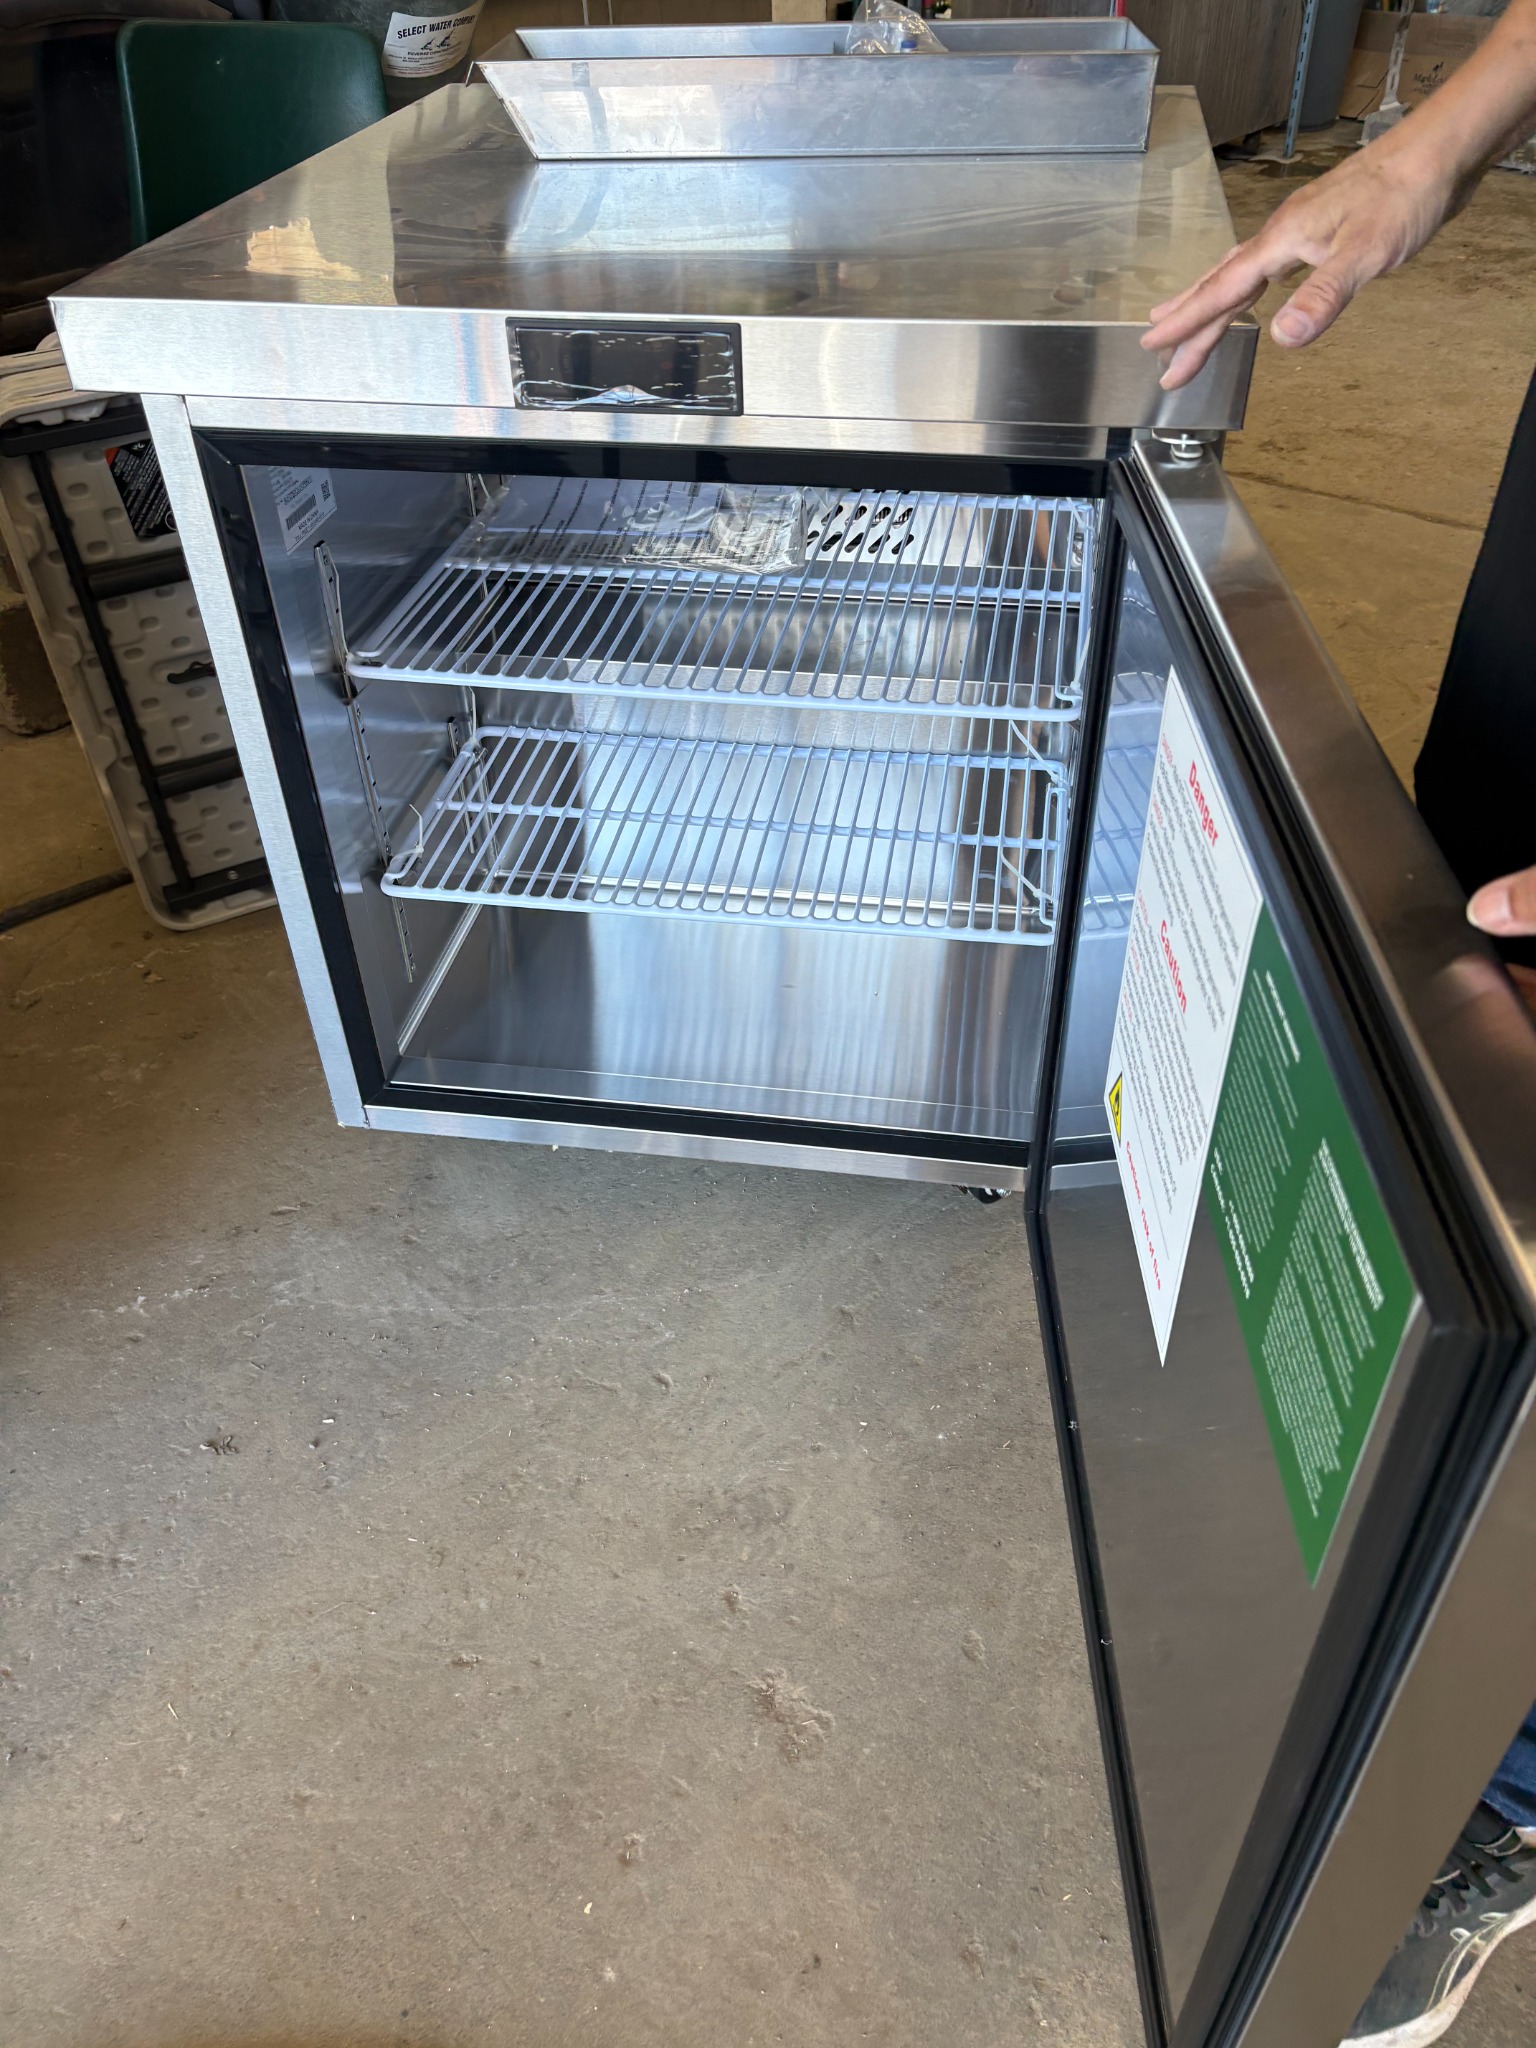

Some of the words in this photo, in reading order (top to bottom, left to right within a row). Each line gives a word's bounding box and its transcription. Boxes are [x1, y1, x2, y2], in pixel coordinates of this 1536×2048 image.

[397, 24, 427, 40] SELECT
[429, 20, 452, 32] WATER
[1189, 760, 1218, 846] Danger
[1161, 919, 1188, 1014] Caution
